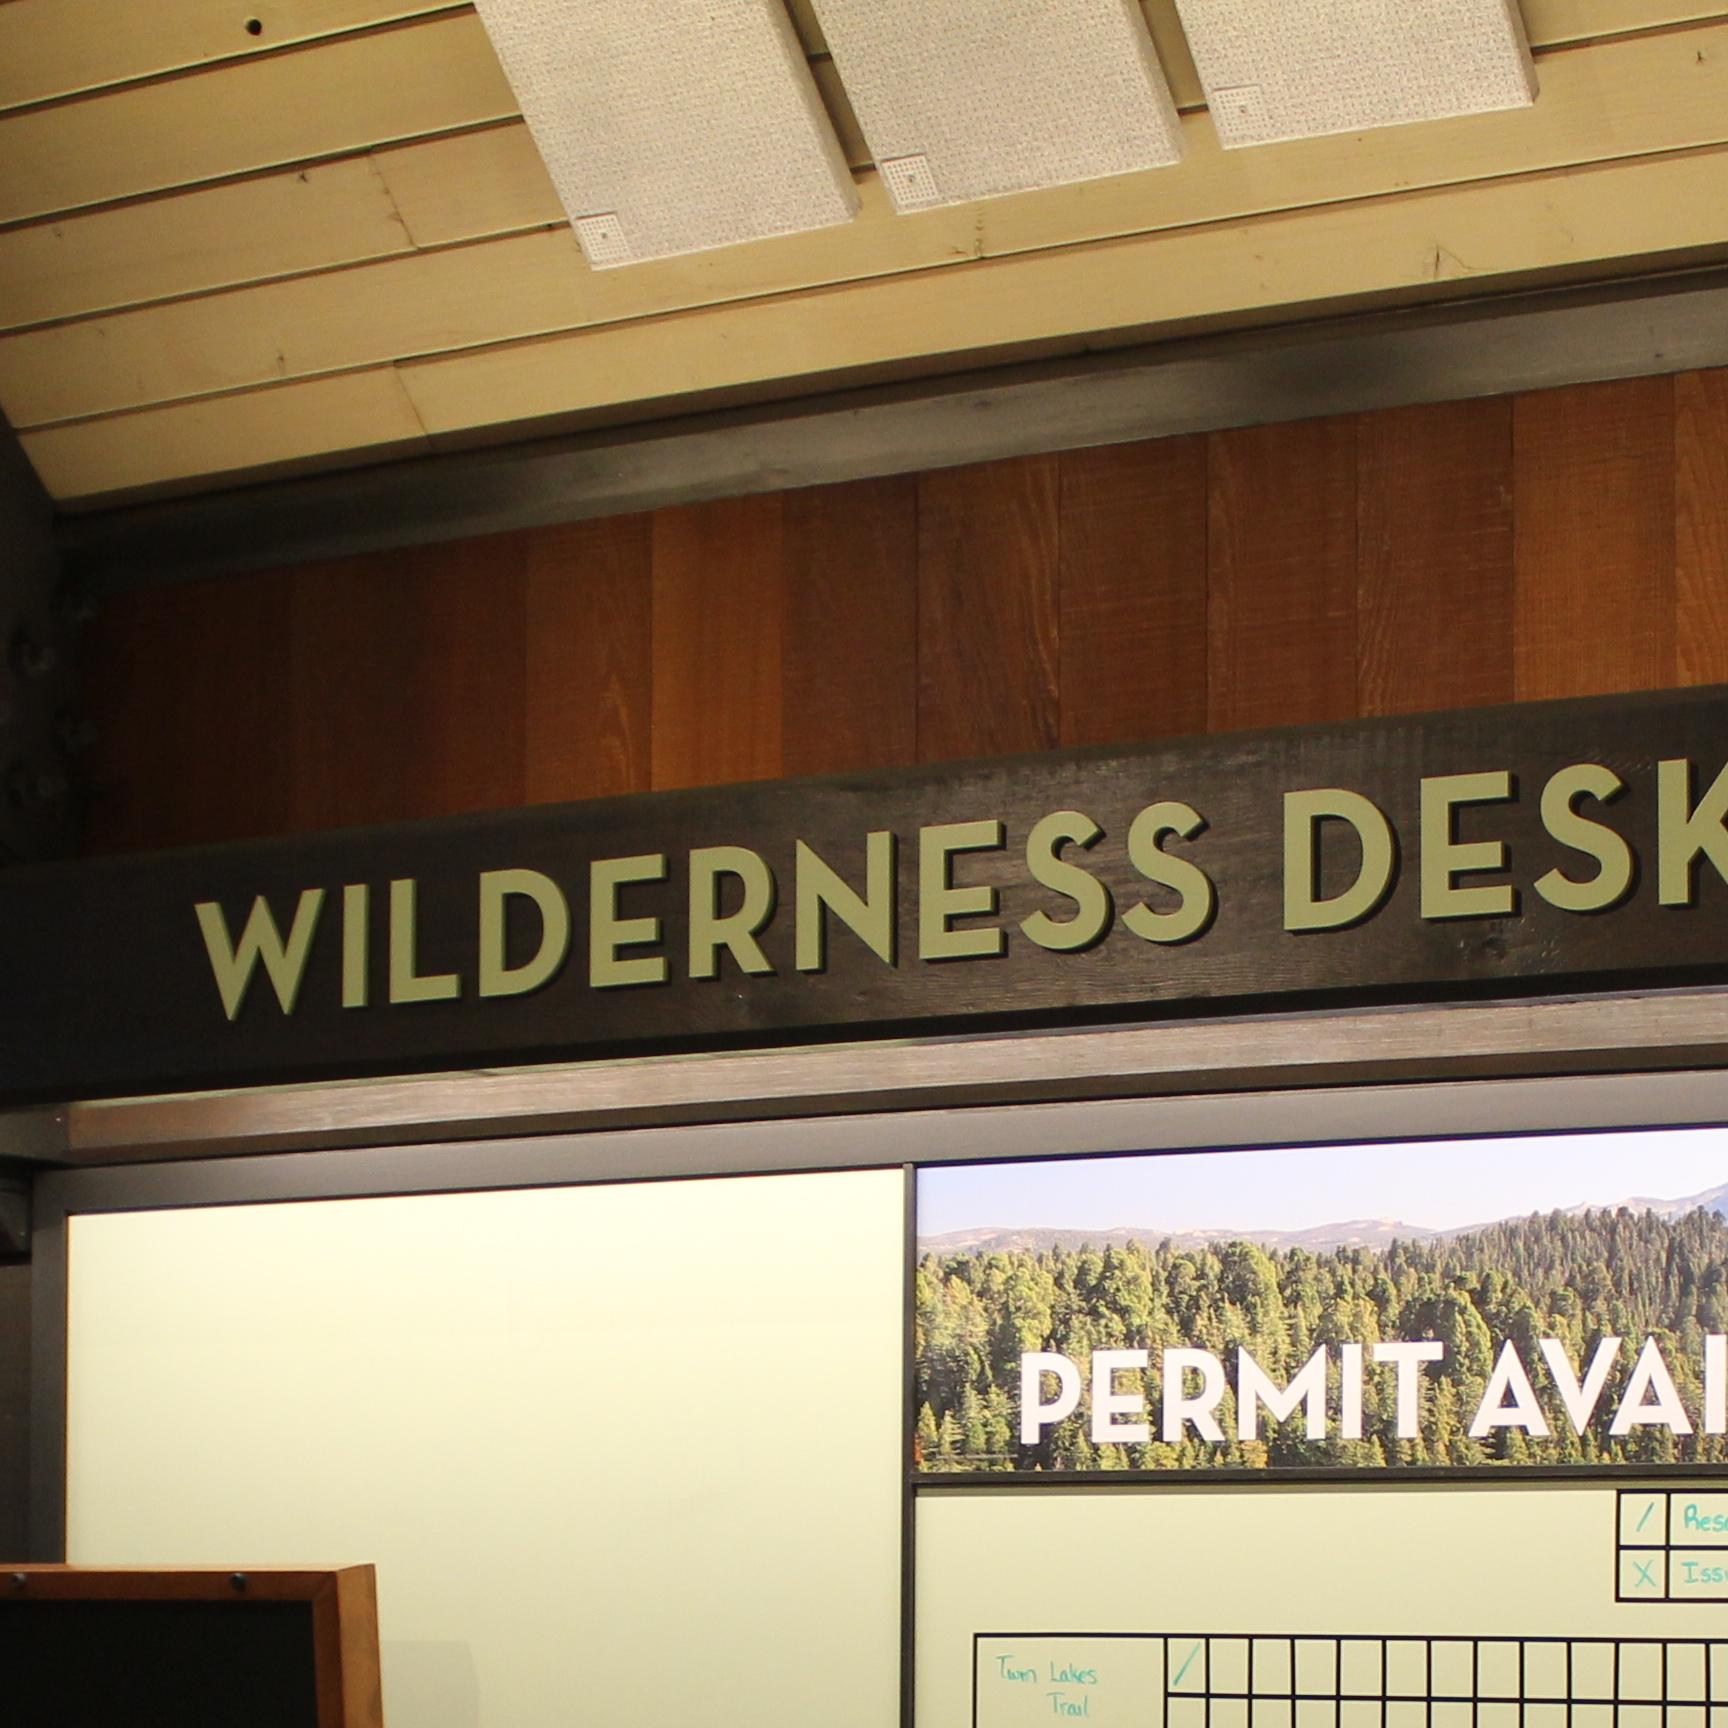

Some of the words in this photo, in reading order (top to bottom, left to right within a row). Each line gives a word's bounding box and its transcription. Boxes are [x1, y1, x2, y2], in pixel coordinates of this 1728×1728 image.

[193, 798, 1216, 1023] WILDERNESS
[1018, 1340, 1446, 1446] PERMIT
[995, 1655, 1037, 1683] Twin
[1050, 1661, 1098, 1684] Lakes
[1046, 1692, 1089, 1717] Trail
